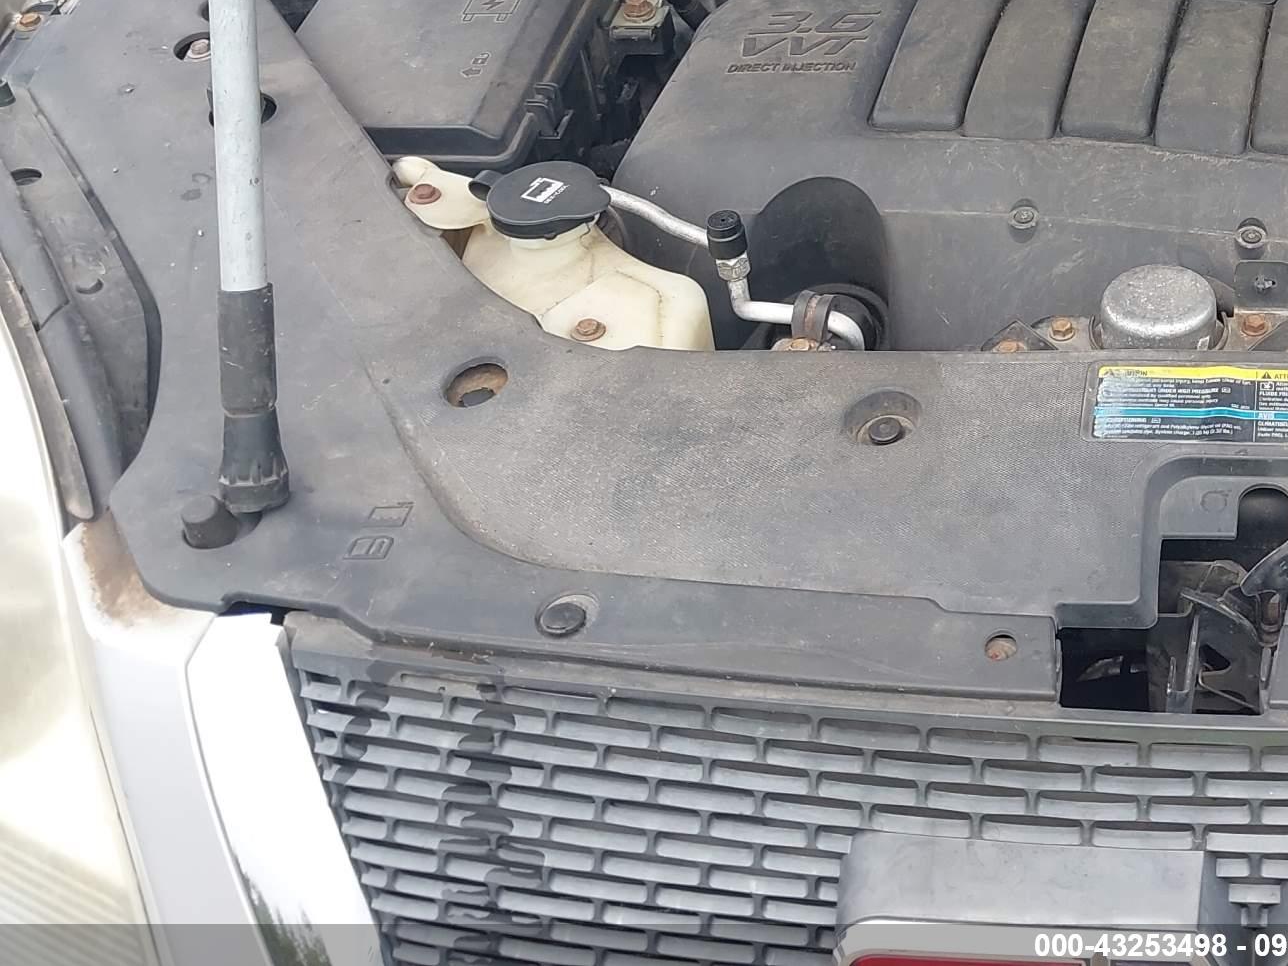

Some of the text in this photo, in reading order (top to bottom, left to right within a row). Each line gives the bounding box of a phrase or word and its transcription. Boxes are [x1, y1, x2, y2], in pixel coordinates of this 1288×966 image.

[748, 10, 882, 35] 3.6
[740, 35, 869, 58] VVT
[726, 61, 857, 74] DIRECT INJECTION
